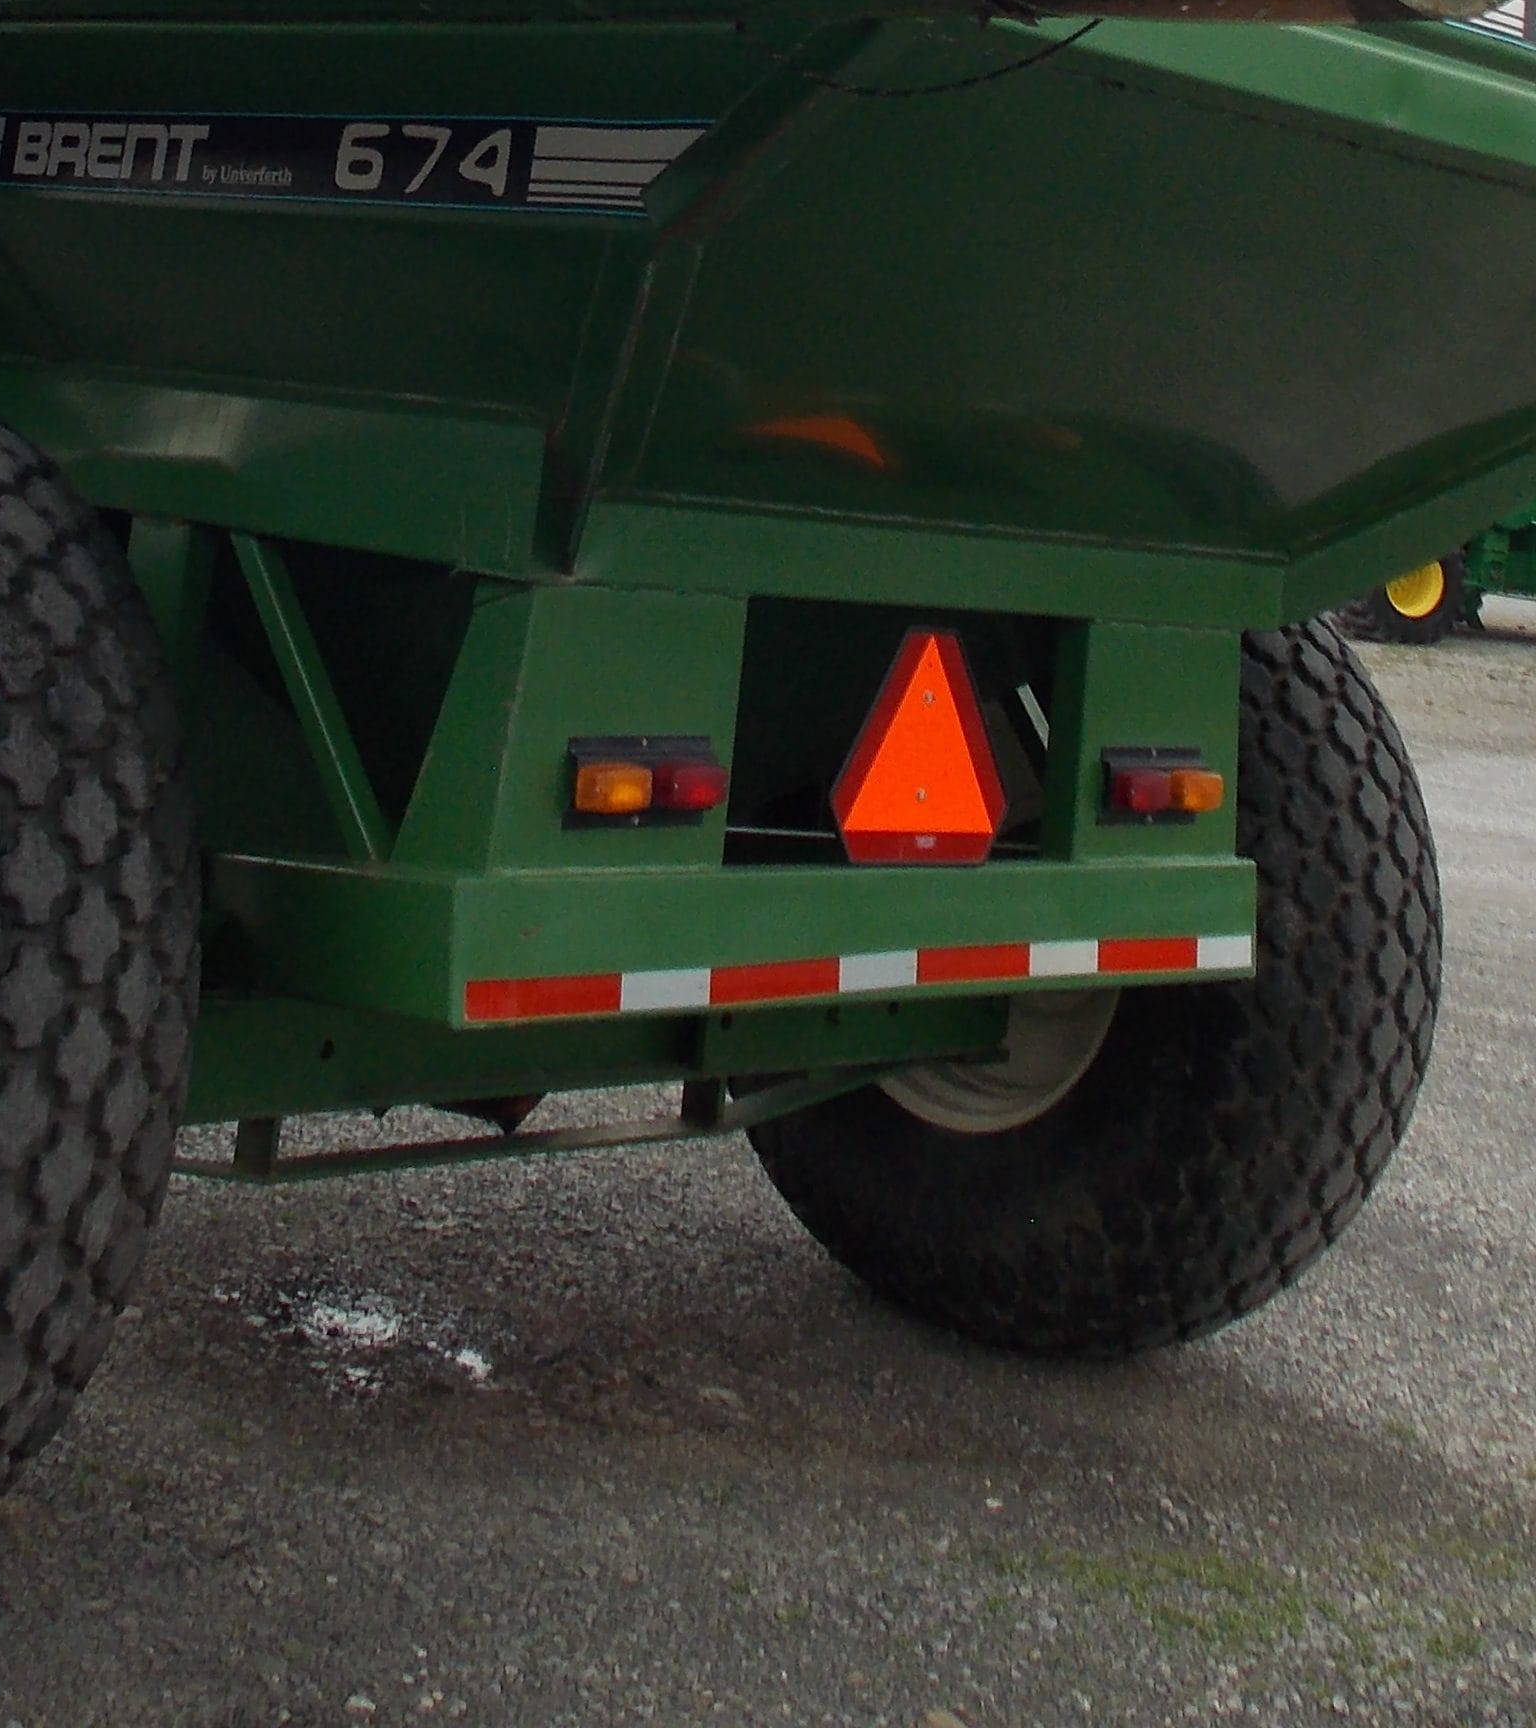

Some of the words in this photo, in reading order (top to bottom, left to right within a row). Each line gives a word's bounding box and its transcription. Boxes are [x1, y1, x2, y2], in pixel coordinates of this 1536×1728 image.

[13, 122, 211, 181] BRENT
[202, 165, 218, 184] by
[335, 123, 512, 197] 674
